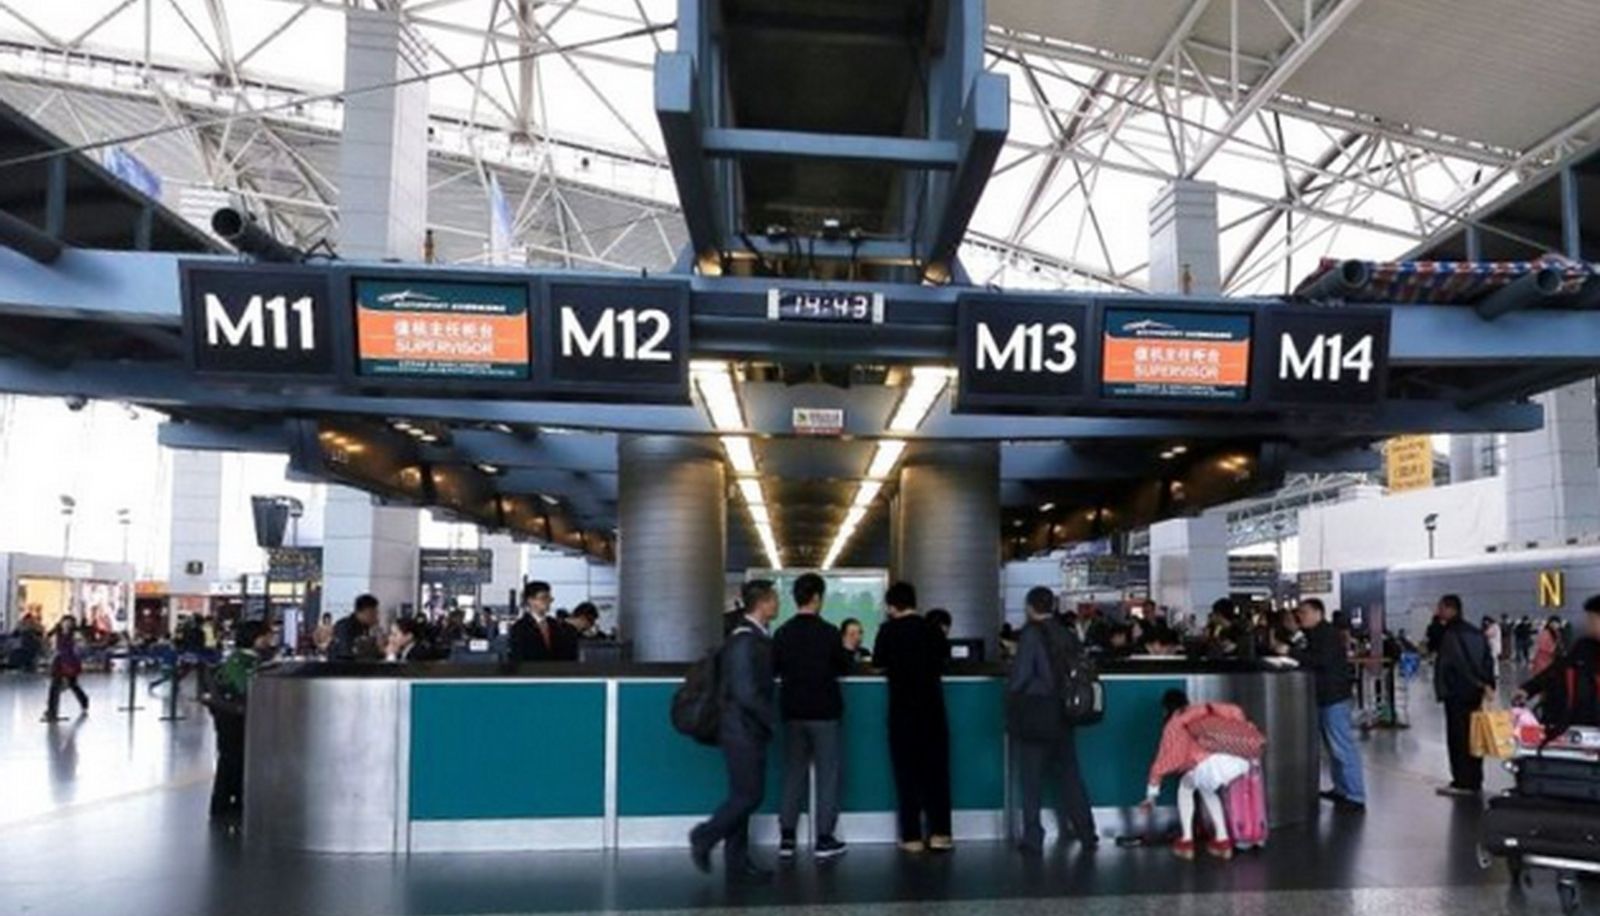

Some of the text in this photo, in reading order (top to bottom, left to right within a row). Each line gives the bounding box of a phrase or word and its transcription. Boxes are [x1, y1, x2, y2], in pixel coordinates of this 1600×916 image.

[205, 293, 314, 350] M11
[793, 296, 868, 319] 14:43
[394, 338, 494, 356] SUPERVISOR
[561, 306, 672, 361] M12
[976, 322, 1077, 373] M13
[1134, 362, 1219, 379] SUPERVISOR
[1279, 332, 1373, 382] M14
[1539, 571, 1562, 607] N
